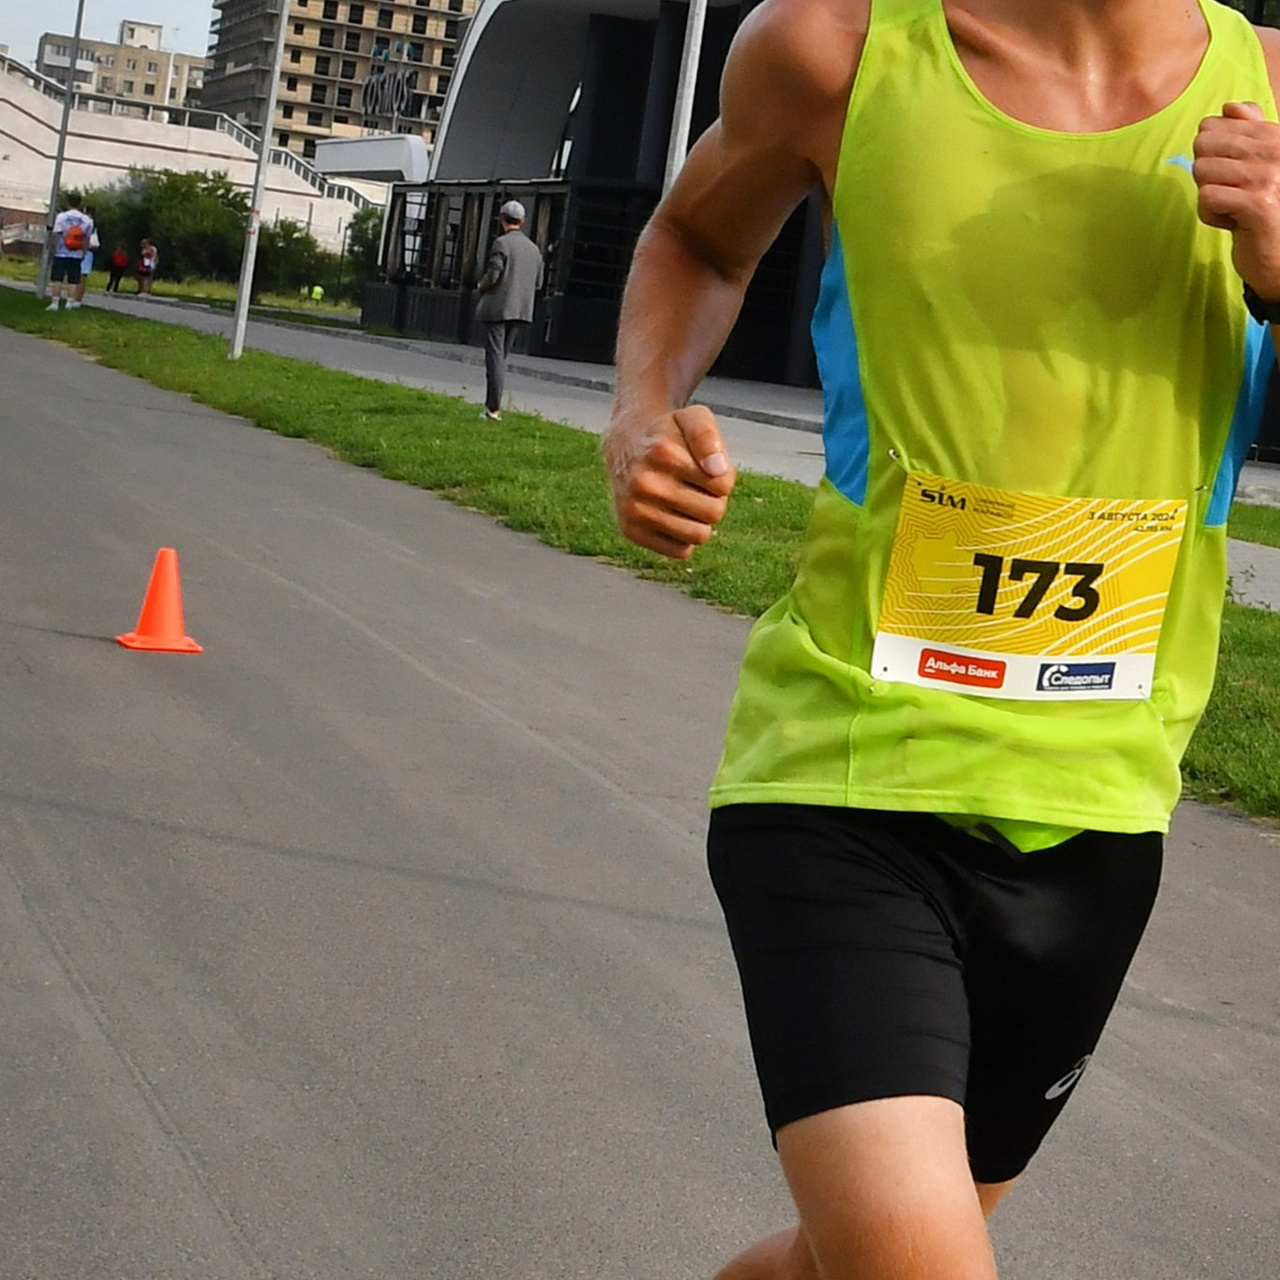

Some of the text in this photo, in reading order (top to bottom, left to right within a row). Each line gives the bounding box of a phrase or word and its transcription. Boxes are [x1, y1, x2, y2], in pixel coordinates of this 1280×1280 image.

[361, 69, 413, 114] COSMOS
[1097, 512, 1147, 521] АВГУСТА
[973, 553, 1104, 621] 173
[924, 657, 998, 679] Альфа Банк
[1051, 673, 1111, 685] Следопыт
